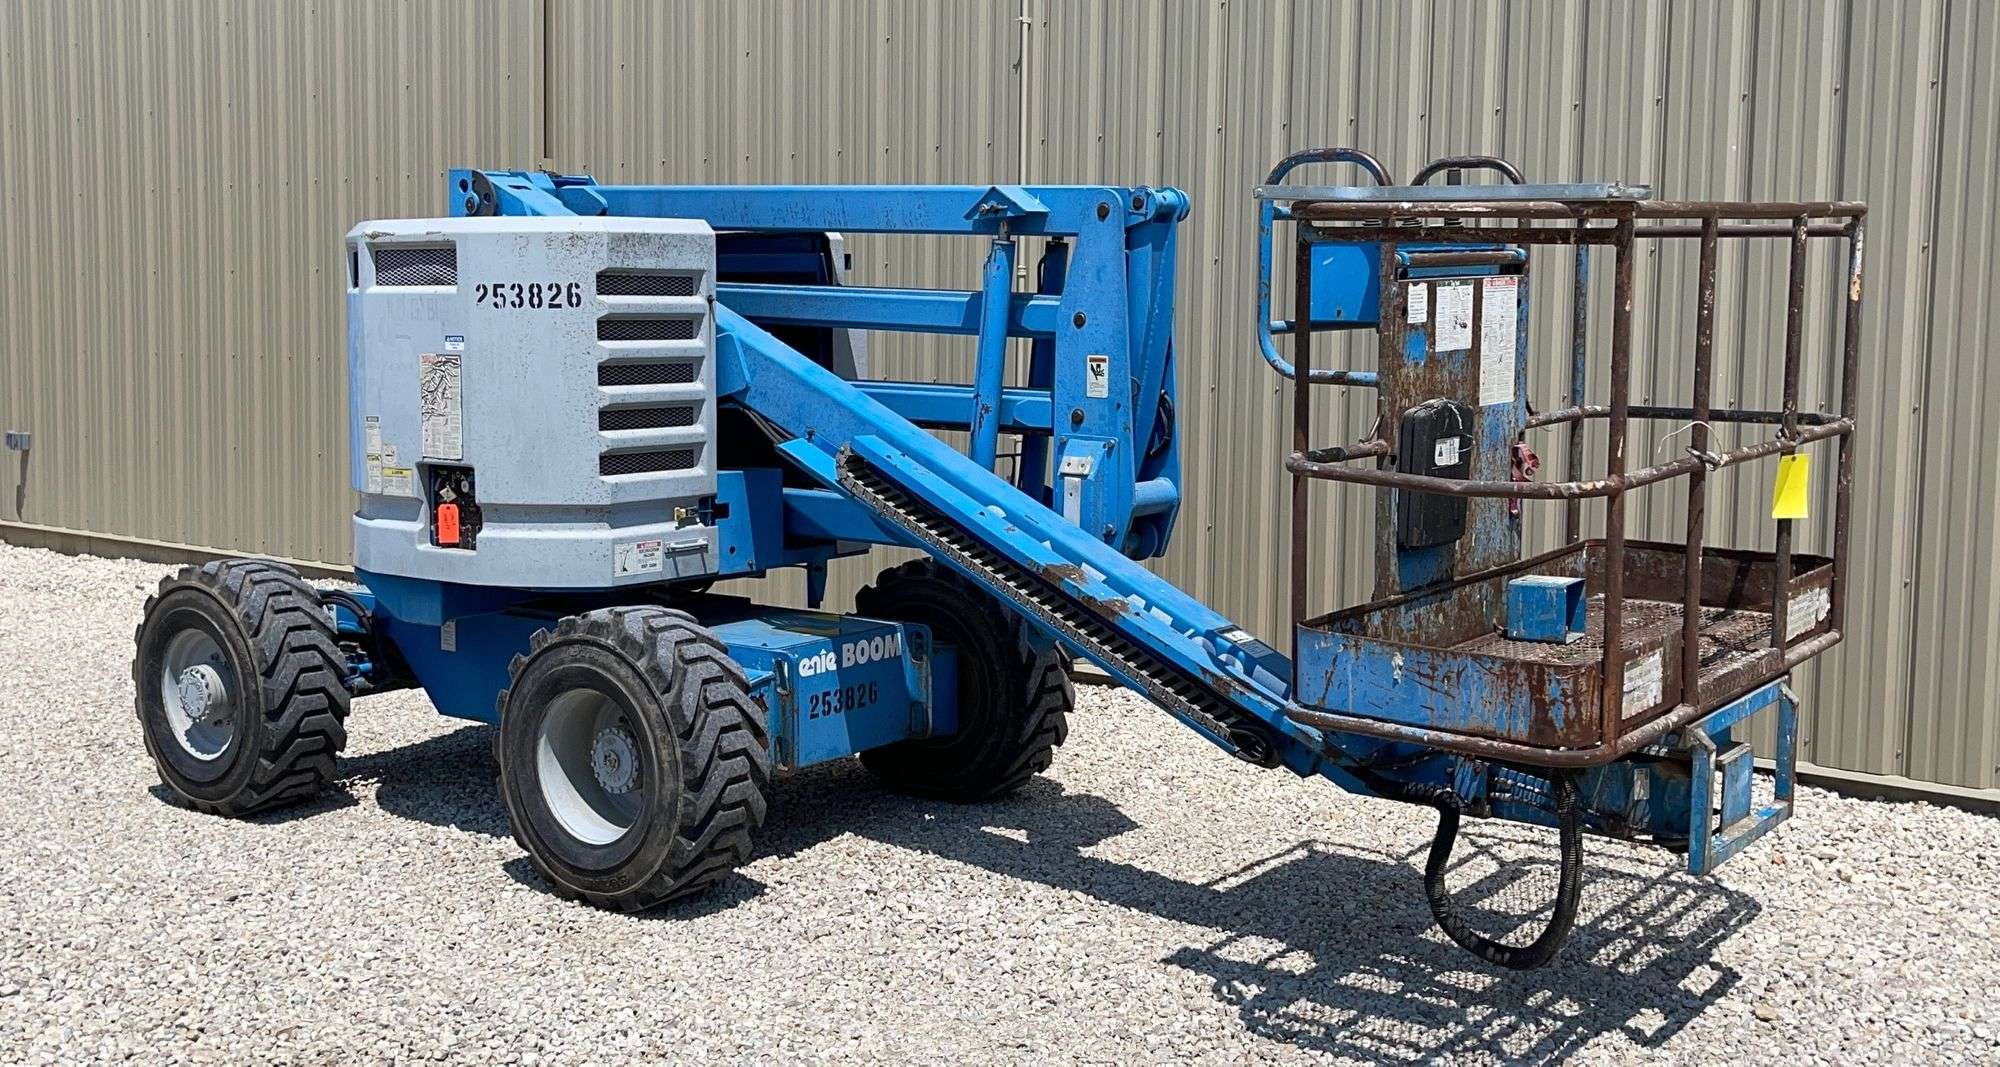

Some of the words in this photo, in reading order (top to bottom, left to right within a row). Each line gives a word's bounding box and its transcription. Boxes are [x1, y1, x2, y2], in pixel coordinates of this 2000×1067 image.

[475, 283, 582, 309] 253826
[798, 649, 837, 677] enie
[842, 633, 902, 668] BOOM
[809, 680, 878, 720] 253826
